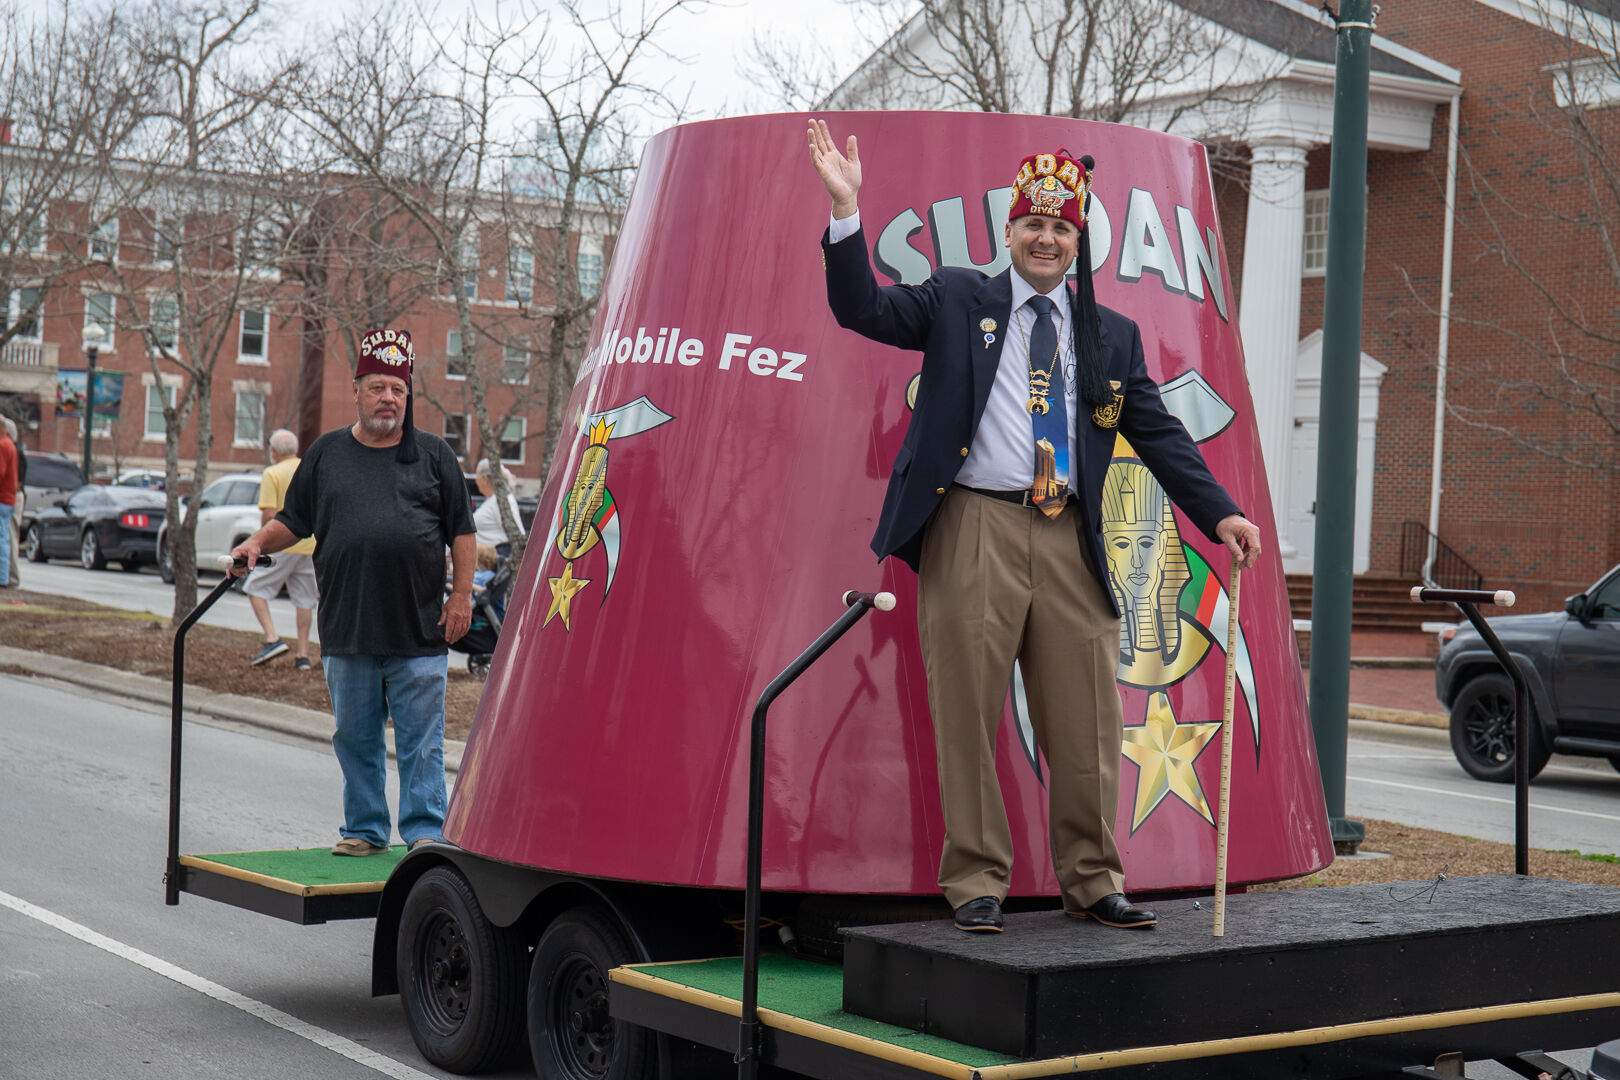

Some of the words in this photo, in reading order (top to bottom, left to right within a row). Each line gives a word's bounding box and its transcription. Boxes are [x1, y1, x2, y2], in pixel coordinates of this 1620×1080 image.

[361, 329, 415, 367] SUDAN
[598, 327, 704, 367] Mobile
[718, 333, 808, 382] Fez
